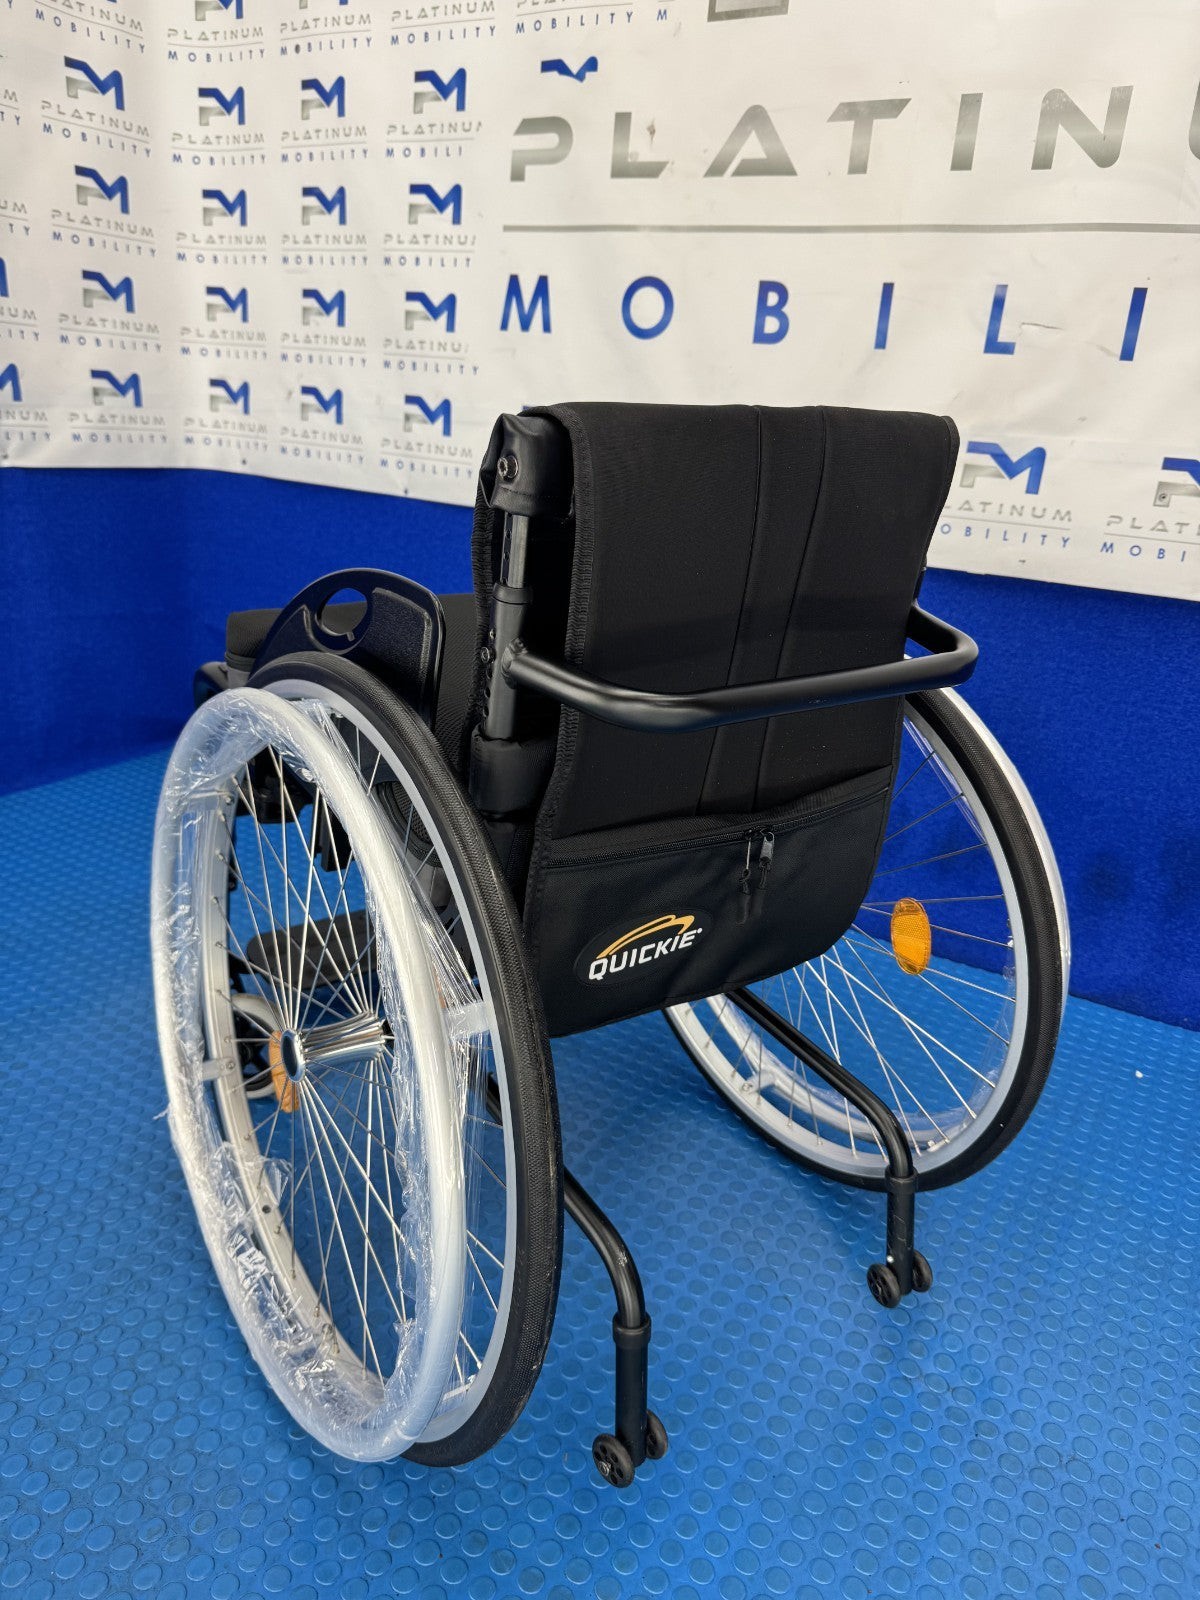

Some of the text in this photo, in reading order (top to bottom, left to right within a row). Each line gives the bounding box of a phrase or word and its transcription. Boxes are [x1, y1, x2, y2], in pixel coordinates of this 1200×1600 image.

[50, 0, 143, 32] ATINUM
[382, 338, 469, 354] PLATINU
[944, 499, 1072, 523] ATINUM
[940, 523, 1071, 548] OBILITY
[588, 928, 700, 981] QUICKIE
